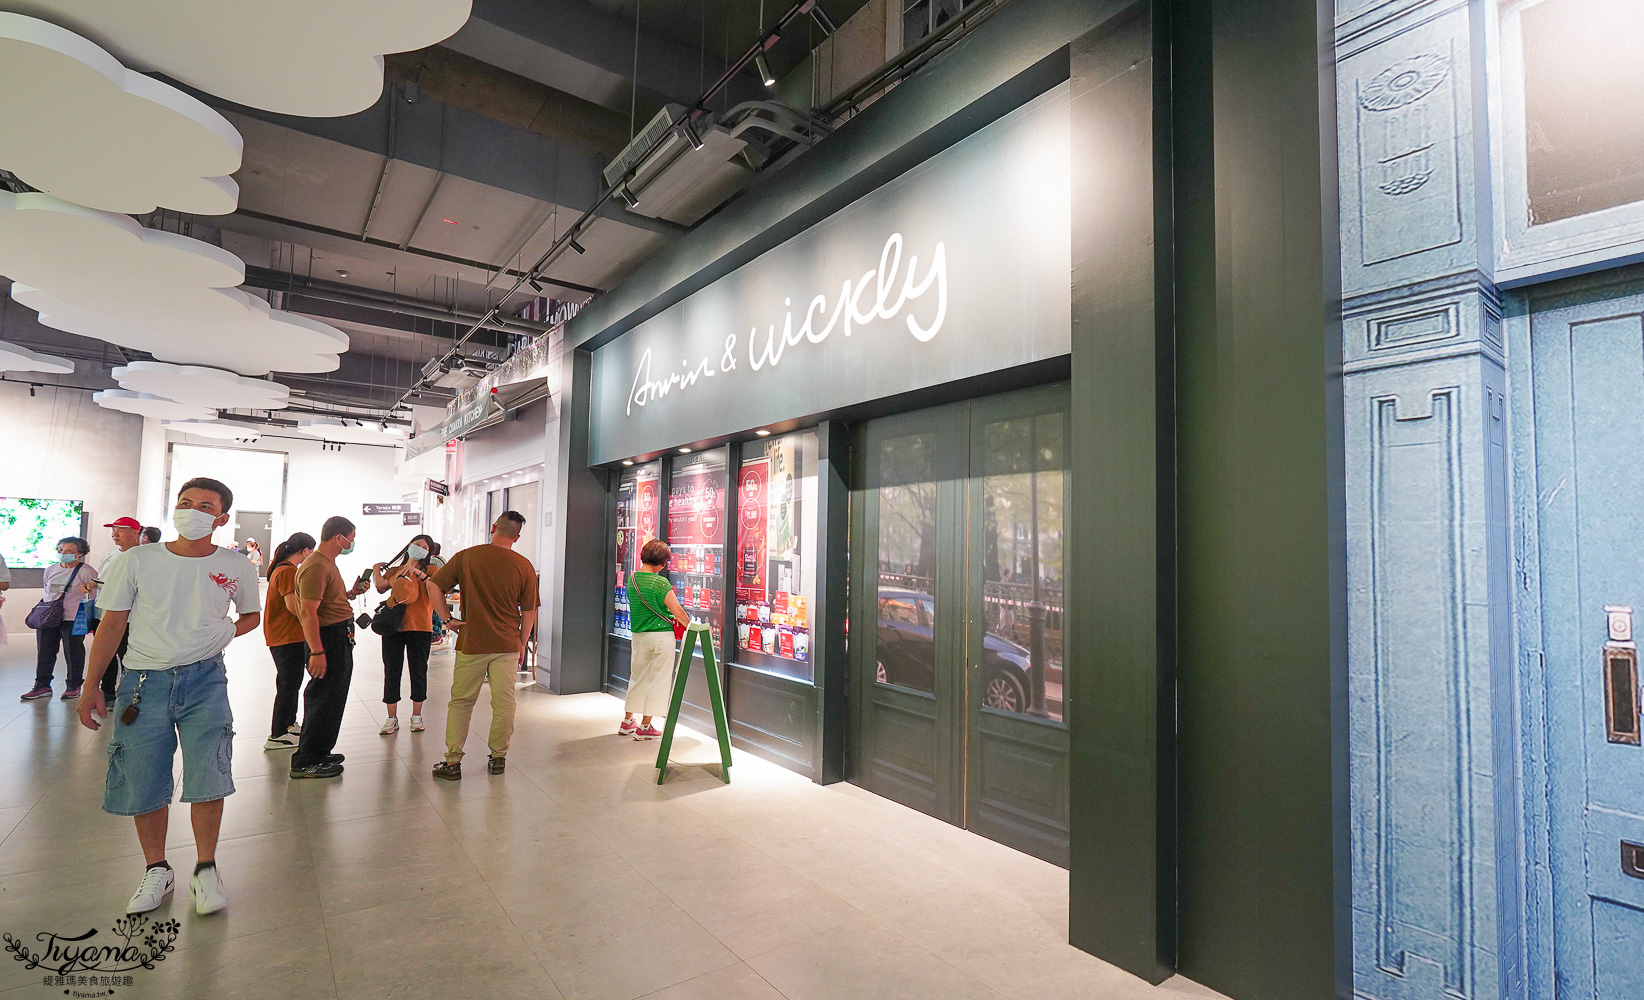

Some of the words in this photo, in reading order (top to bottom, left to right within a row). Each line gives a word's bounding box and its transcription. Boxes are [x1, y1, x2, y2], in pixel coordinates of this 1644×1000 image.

[721, 333, 737, 372] &
[672, 486, 686, 497] pays
[687, 484, 695, 493] to
